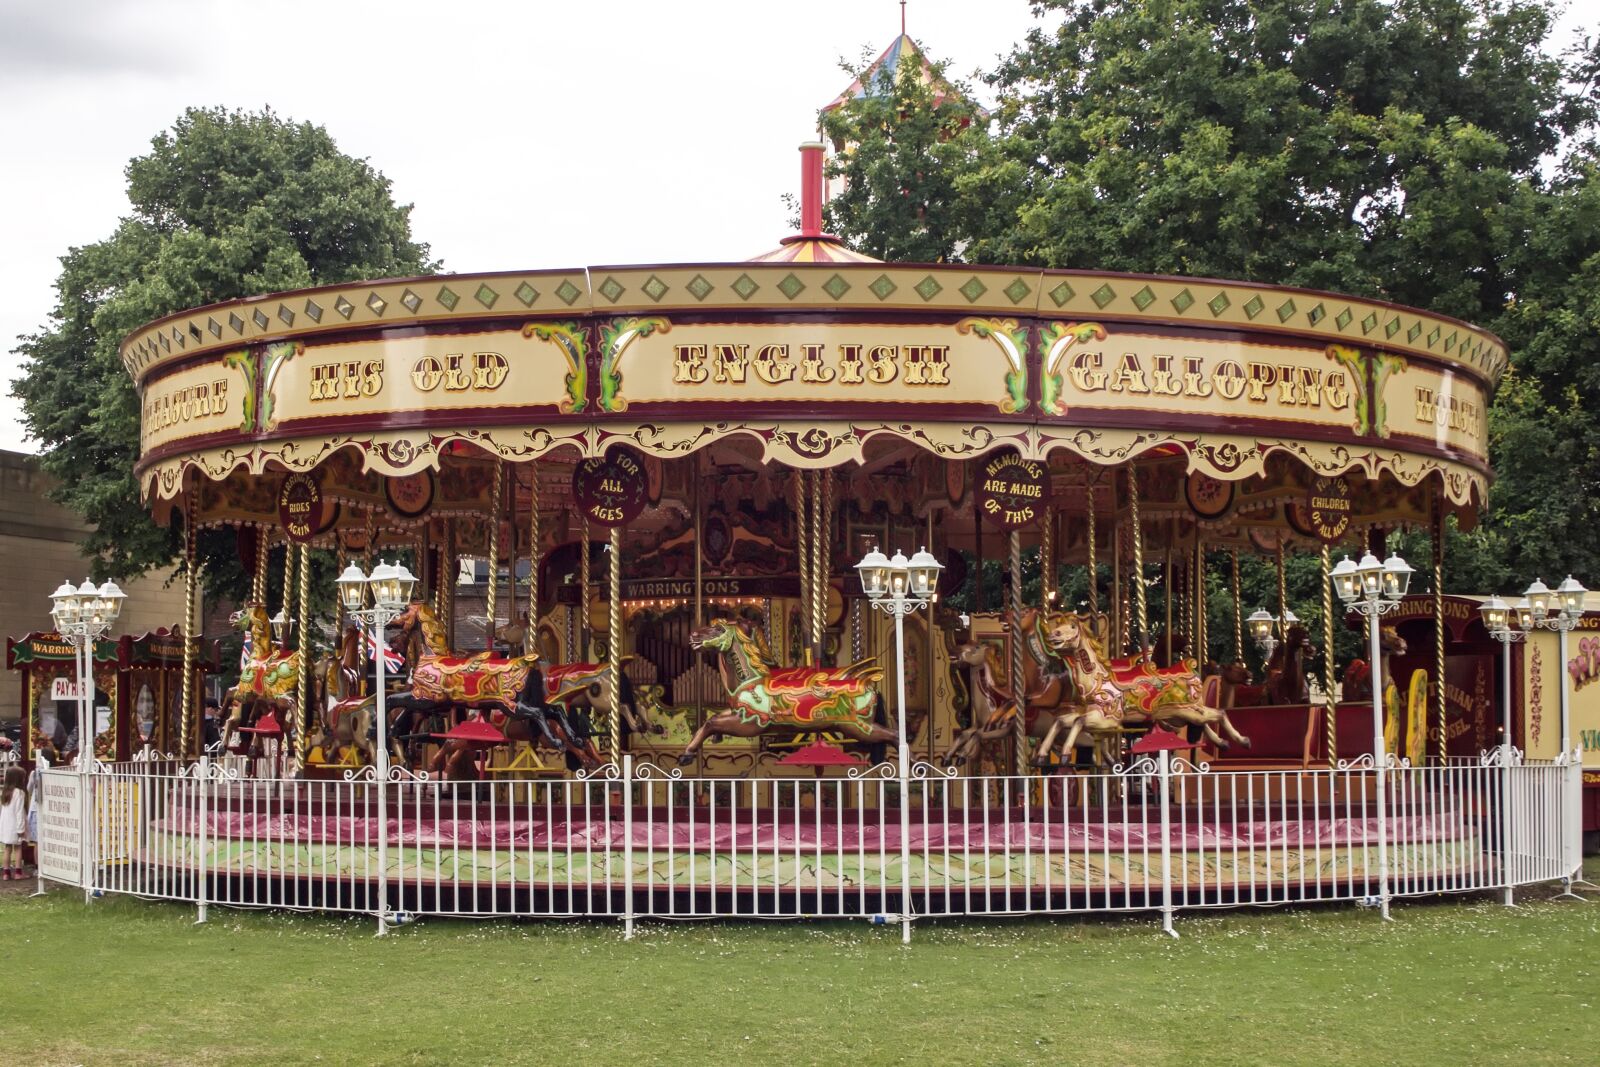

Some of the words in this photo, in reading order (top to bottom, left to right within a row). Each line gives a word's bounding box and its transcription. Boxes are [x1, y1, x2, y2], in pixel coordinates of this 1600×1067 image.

[673, 343, 952, 386] ENGLISH
[310, 358, 384, 401] HIS
[410, 351, 510, 394] OLD
[1070, 352, 1349, 410] GALLOPING
[1415, 386, 1480, 440] HORSES
[616, 453, 639, 475] FOR
[985, 453, 1043, 479] MEMORIES
[600, 479, 624, 493] ALL
[984, 480, 1007, 493] ARE
[1009, 483, 1042, 498] MADE
[289, 502, 310, 513] RIDES
[984, 499, 1002, 514] OF
[1005, 506, 1034, 523] THIS
[1311, 496, 1351, 510] CHILDREN
[590, 505, 624, 521] AGES
[287, 522, 310, 536] AGAIN
[628, 580, 740, 597] WARRINGONS
[1381, 600, 1471, 619] ARRINGONS
[33, 642, 97, 655] WARRINGN
[56, 681, 70, 697] PAY
